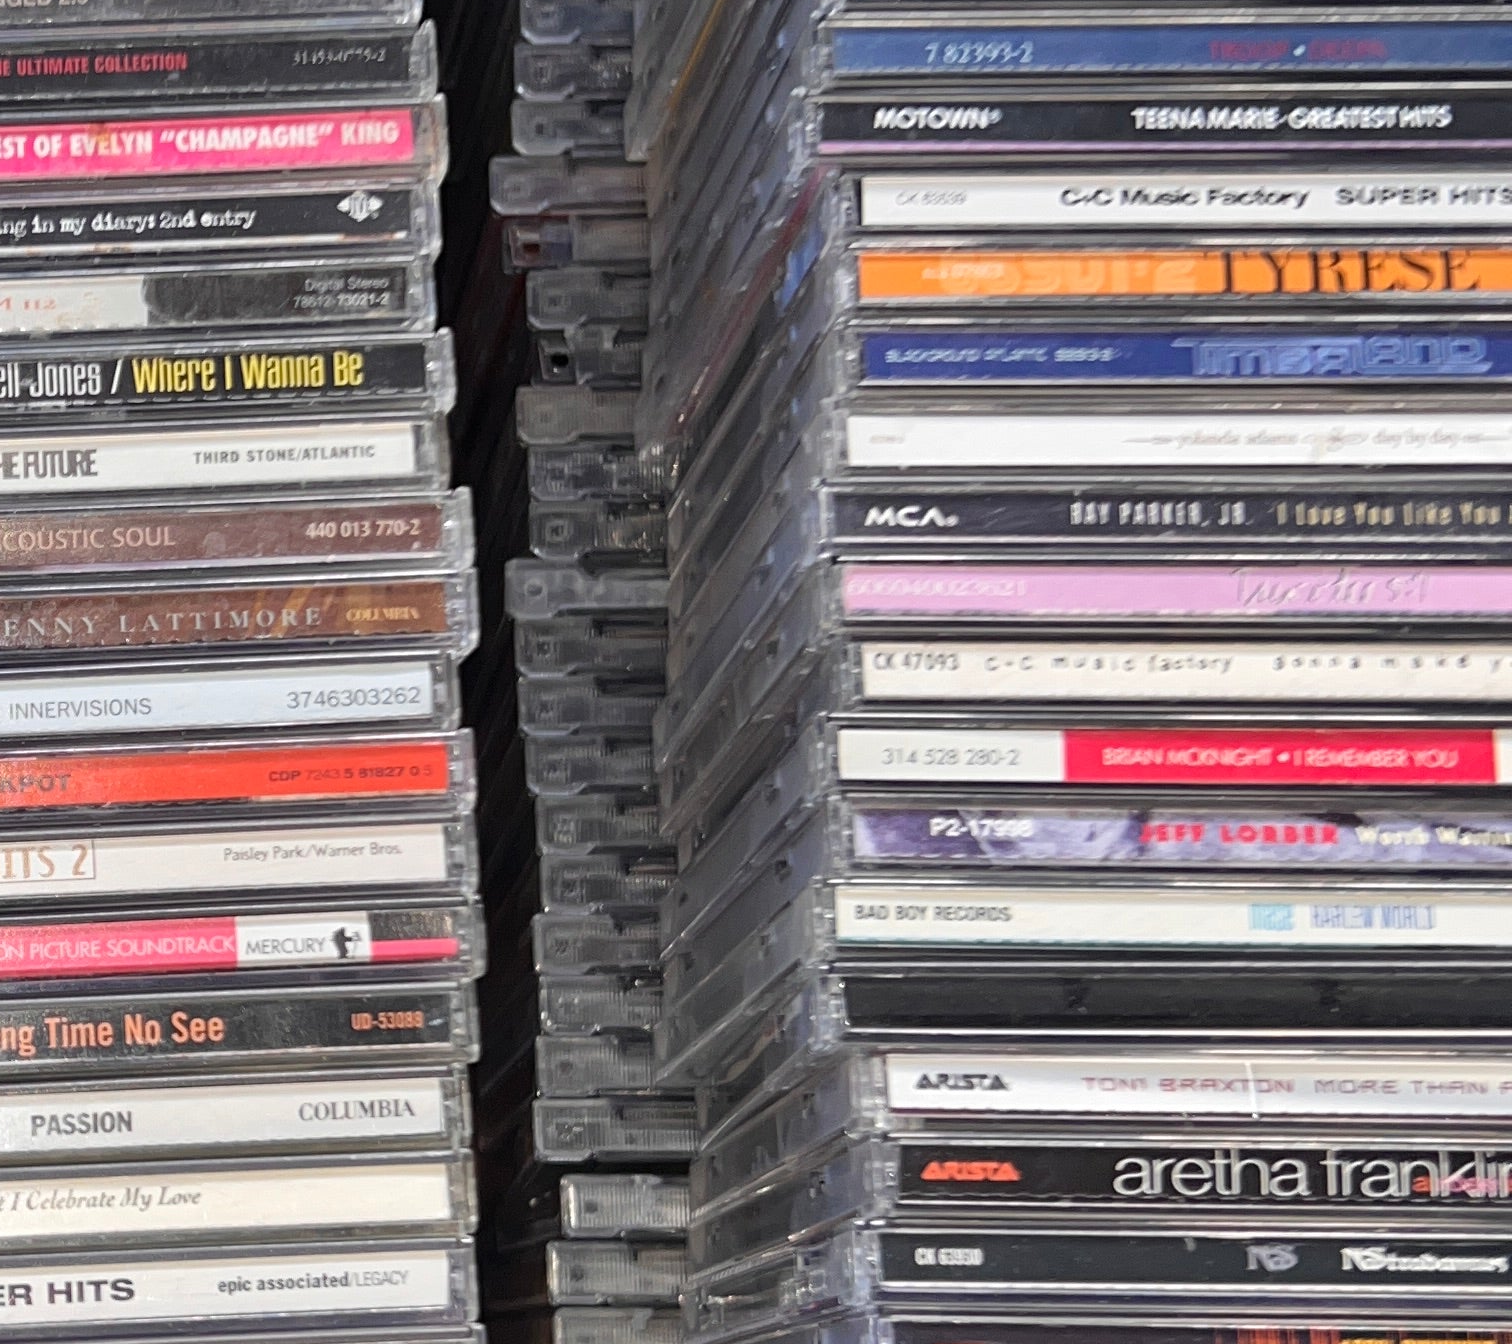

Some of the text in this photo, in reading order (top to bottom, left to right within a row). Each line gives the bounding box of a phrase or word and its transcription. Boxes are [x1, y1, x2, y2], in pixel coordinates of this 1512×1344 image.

[16, 55, 88, 76] ULTIMATE
[94, 53, 187, 74] COLLECTION
[23, 448, 99, 479] FUTURE
[194, 444, 376, 465] THIRD STONE/ATLANTIC
[112, 526, 176, 547] SOUL
[119, 607, 322, 633] LATTIMORE
[286, 686, 422, 709] 3746303262
[854, 905, 1012, 922] BAD BOY RECORDS
[245, 935, 327, 955] MERCURY
[914, 1073, 1009, 1090] ARISTA
[1081, 1077, 1488, 1095] TONI BRAXTON MORE THAN
[298, 1098, 416, 1122] COLUMBIA
[30, 1111, 134, 1137] PASSION
[920, 1161, 1022, 1181] ARISTA
